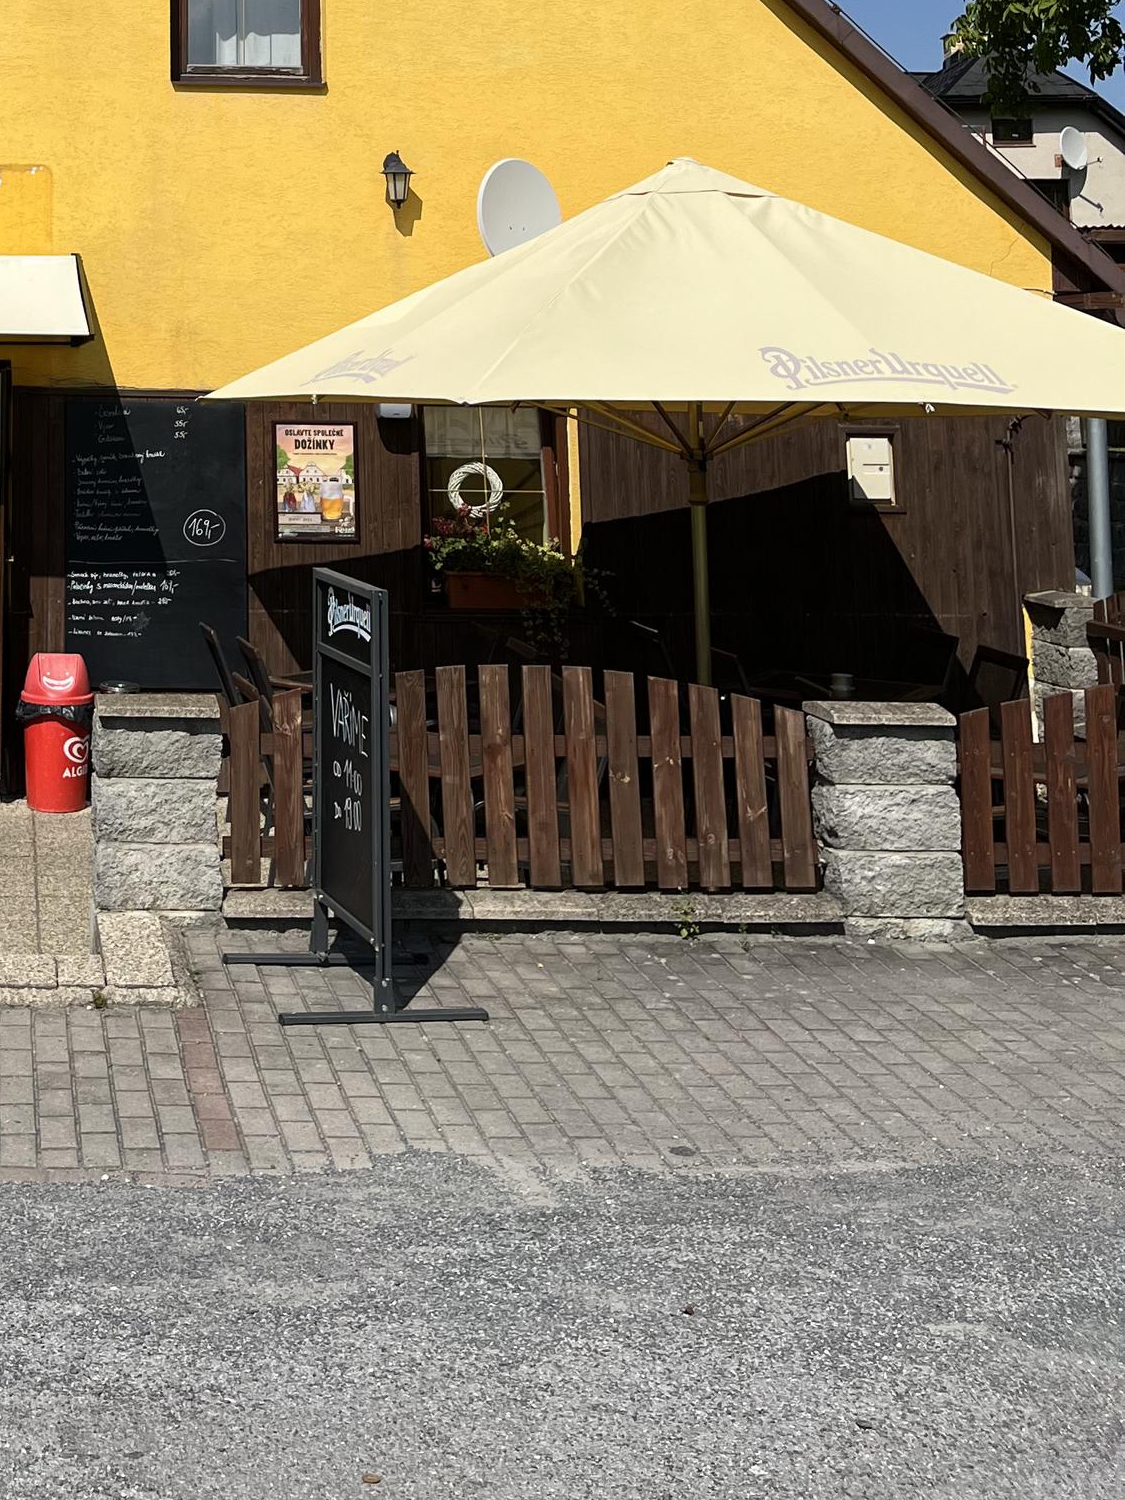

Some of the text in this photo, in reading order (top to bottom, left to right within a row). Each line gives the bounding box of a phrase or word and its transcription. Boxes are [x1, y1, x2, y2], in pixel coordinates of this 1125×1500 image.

[758, 346, 1015, 393] Pilsner Urquell
[284, 428, 312, 437] OSLAVTE
[294, 437, 335, 450] DOŽÍNKY
[188, 517, 220, 540] 169,-
[327, 586, 371, 639] Pilsner Urquell
[330, 682, 369, 758] VAŘÍME
[333, 760, 342, 778] OD
